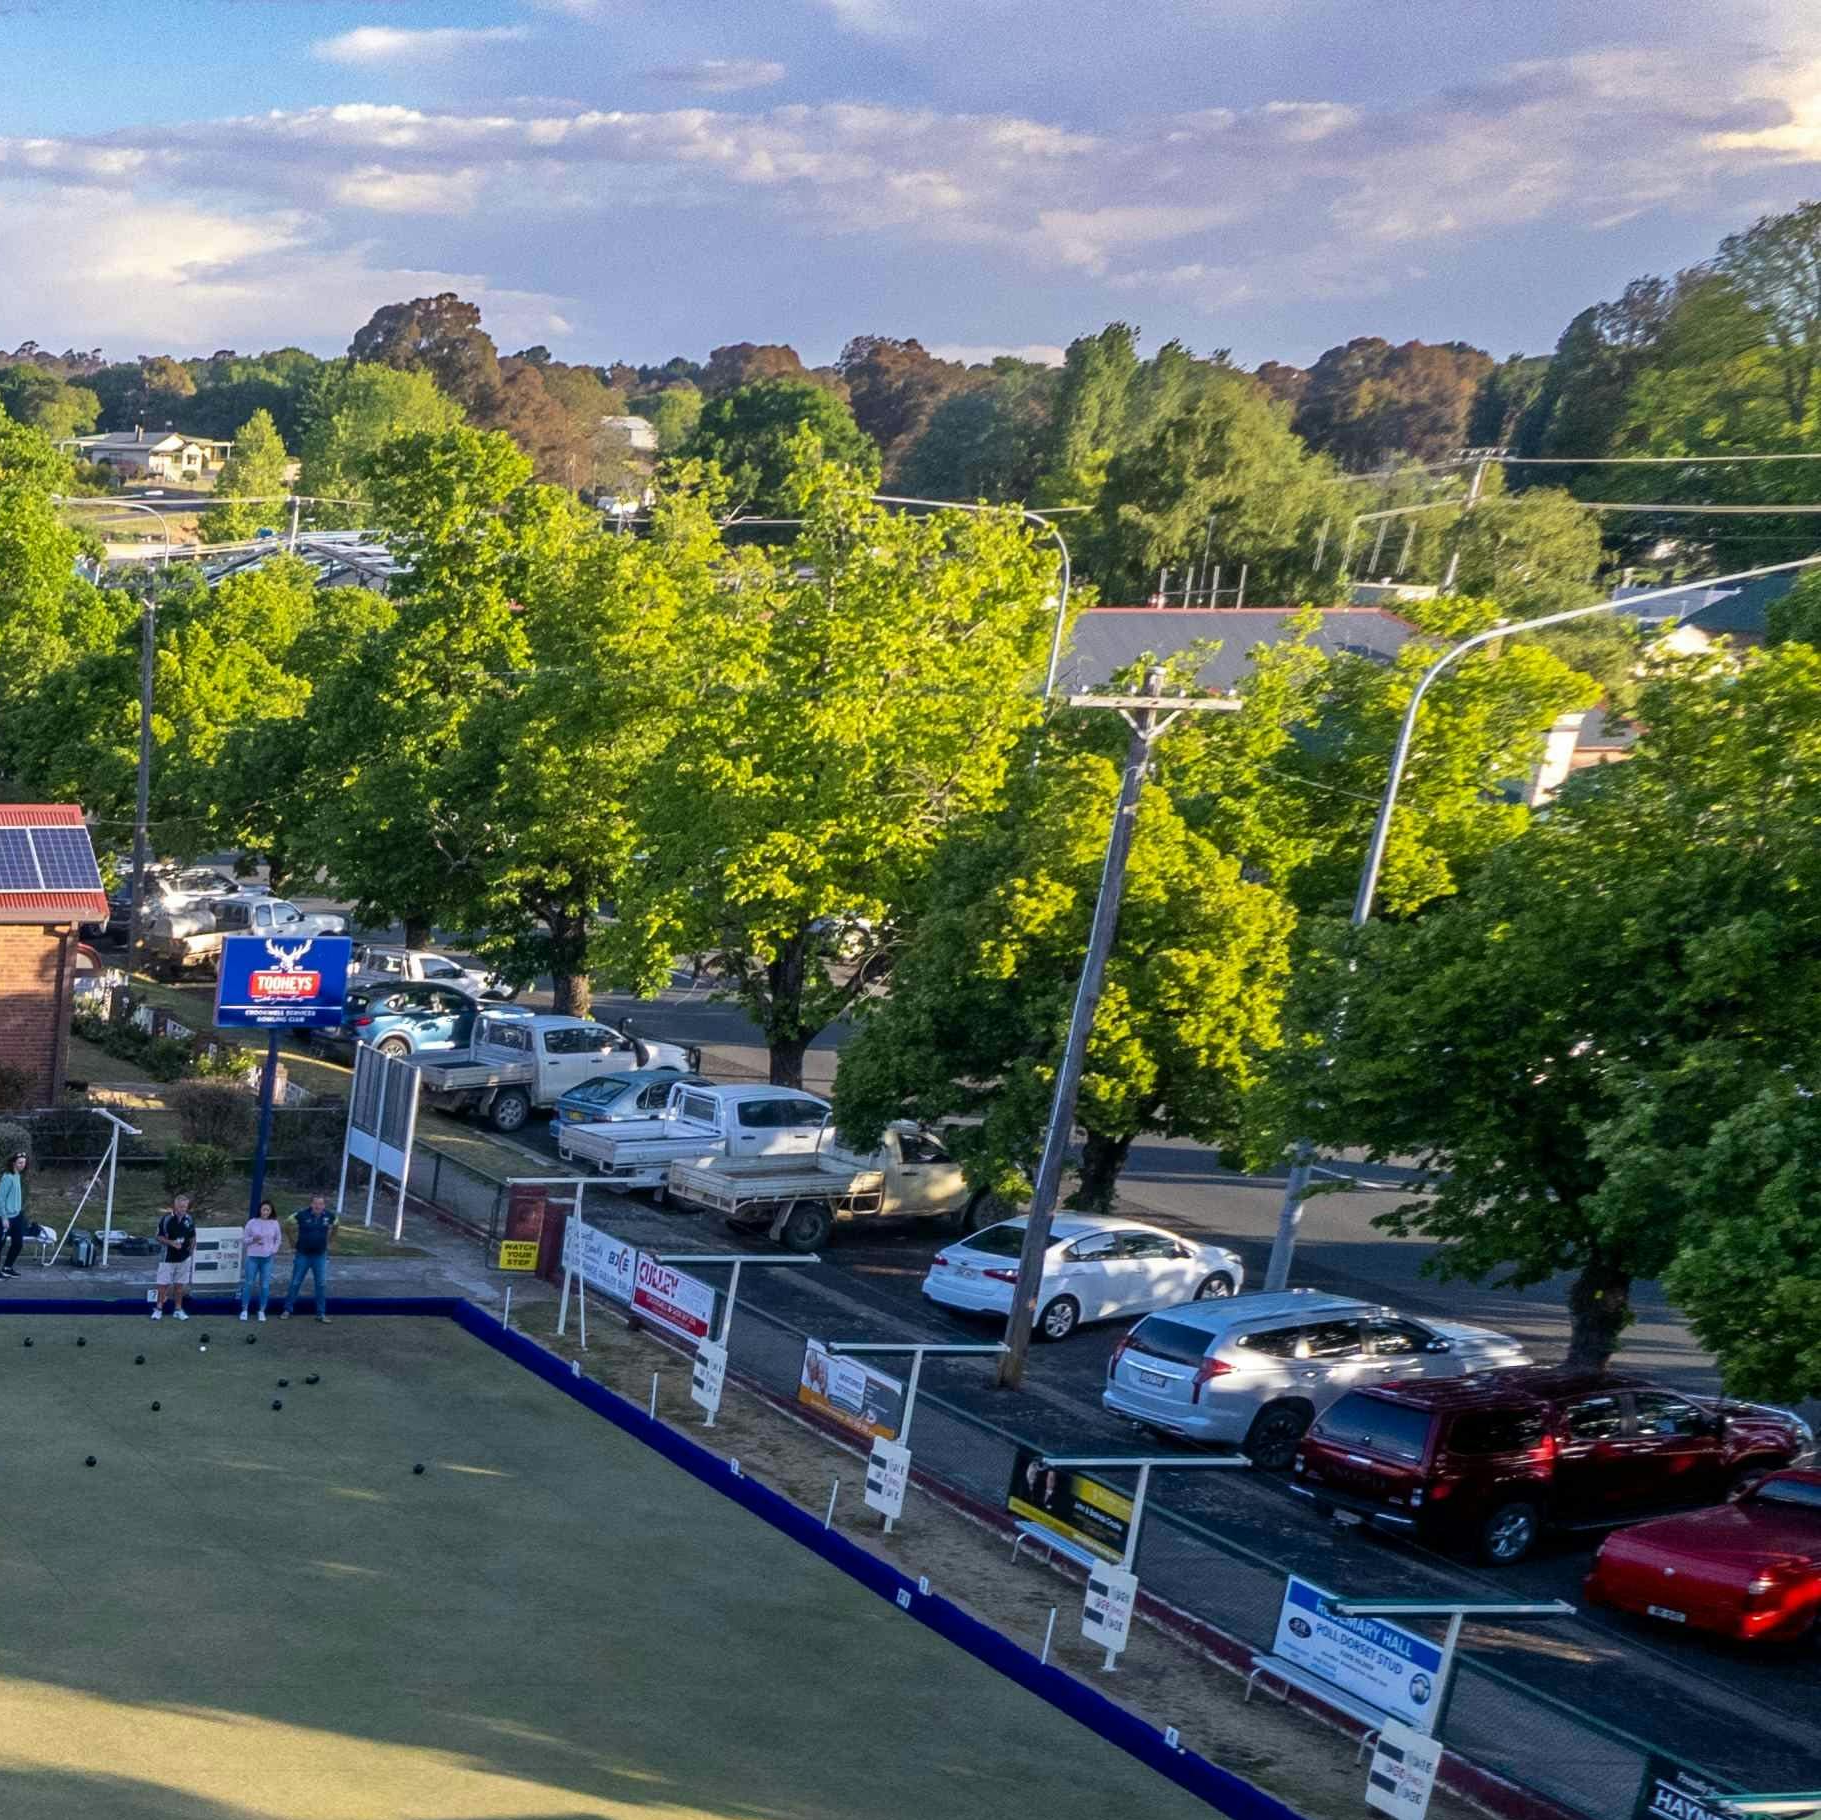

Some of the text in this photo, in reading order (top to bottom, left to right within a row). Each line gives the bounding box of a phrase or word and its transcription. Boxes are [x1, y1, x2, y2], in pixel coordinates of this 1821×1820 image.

[258, 975, 313, 991] TOOHEYS
[1316, 1597, 1413, 1658] RMARY HALL
[1316, 1622, 1339, 1643] POLL
[1340, 1633, 1378, 1660] DORSET
[1377, 1652, 1404, 1675] STUD
